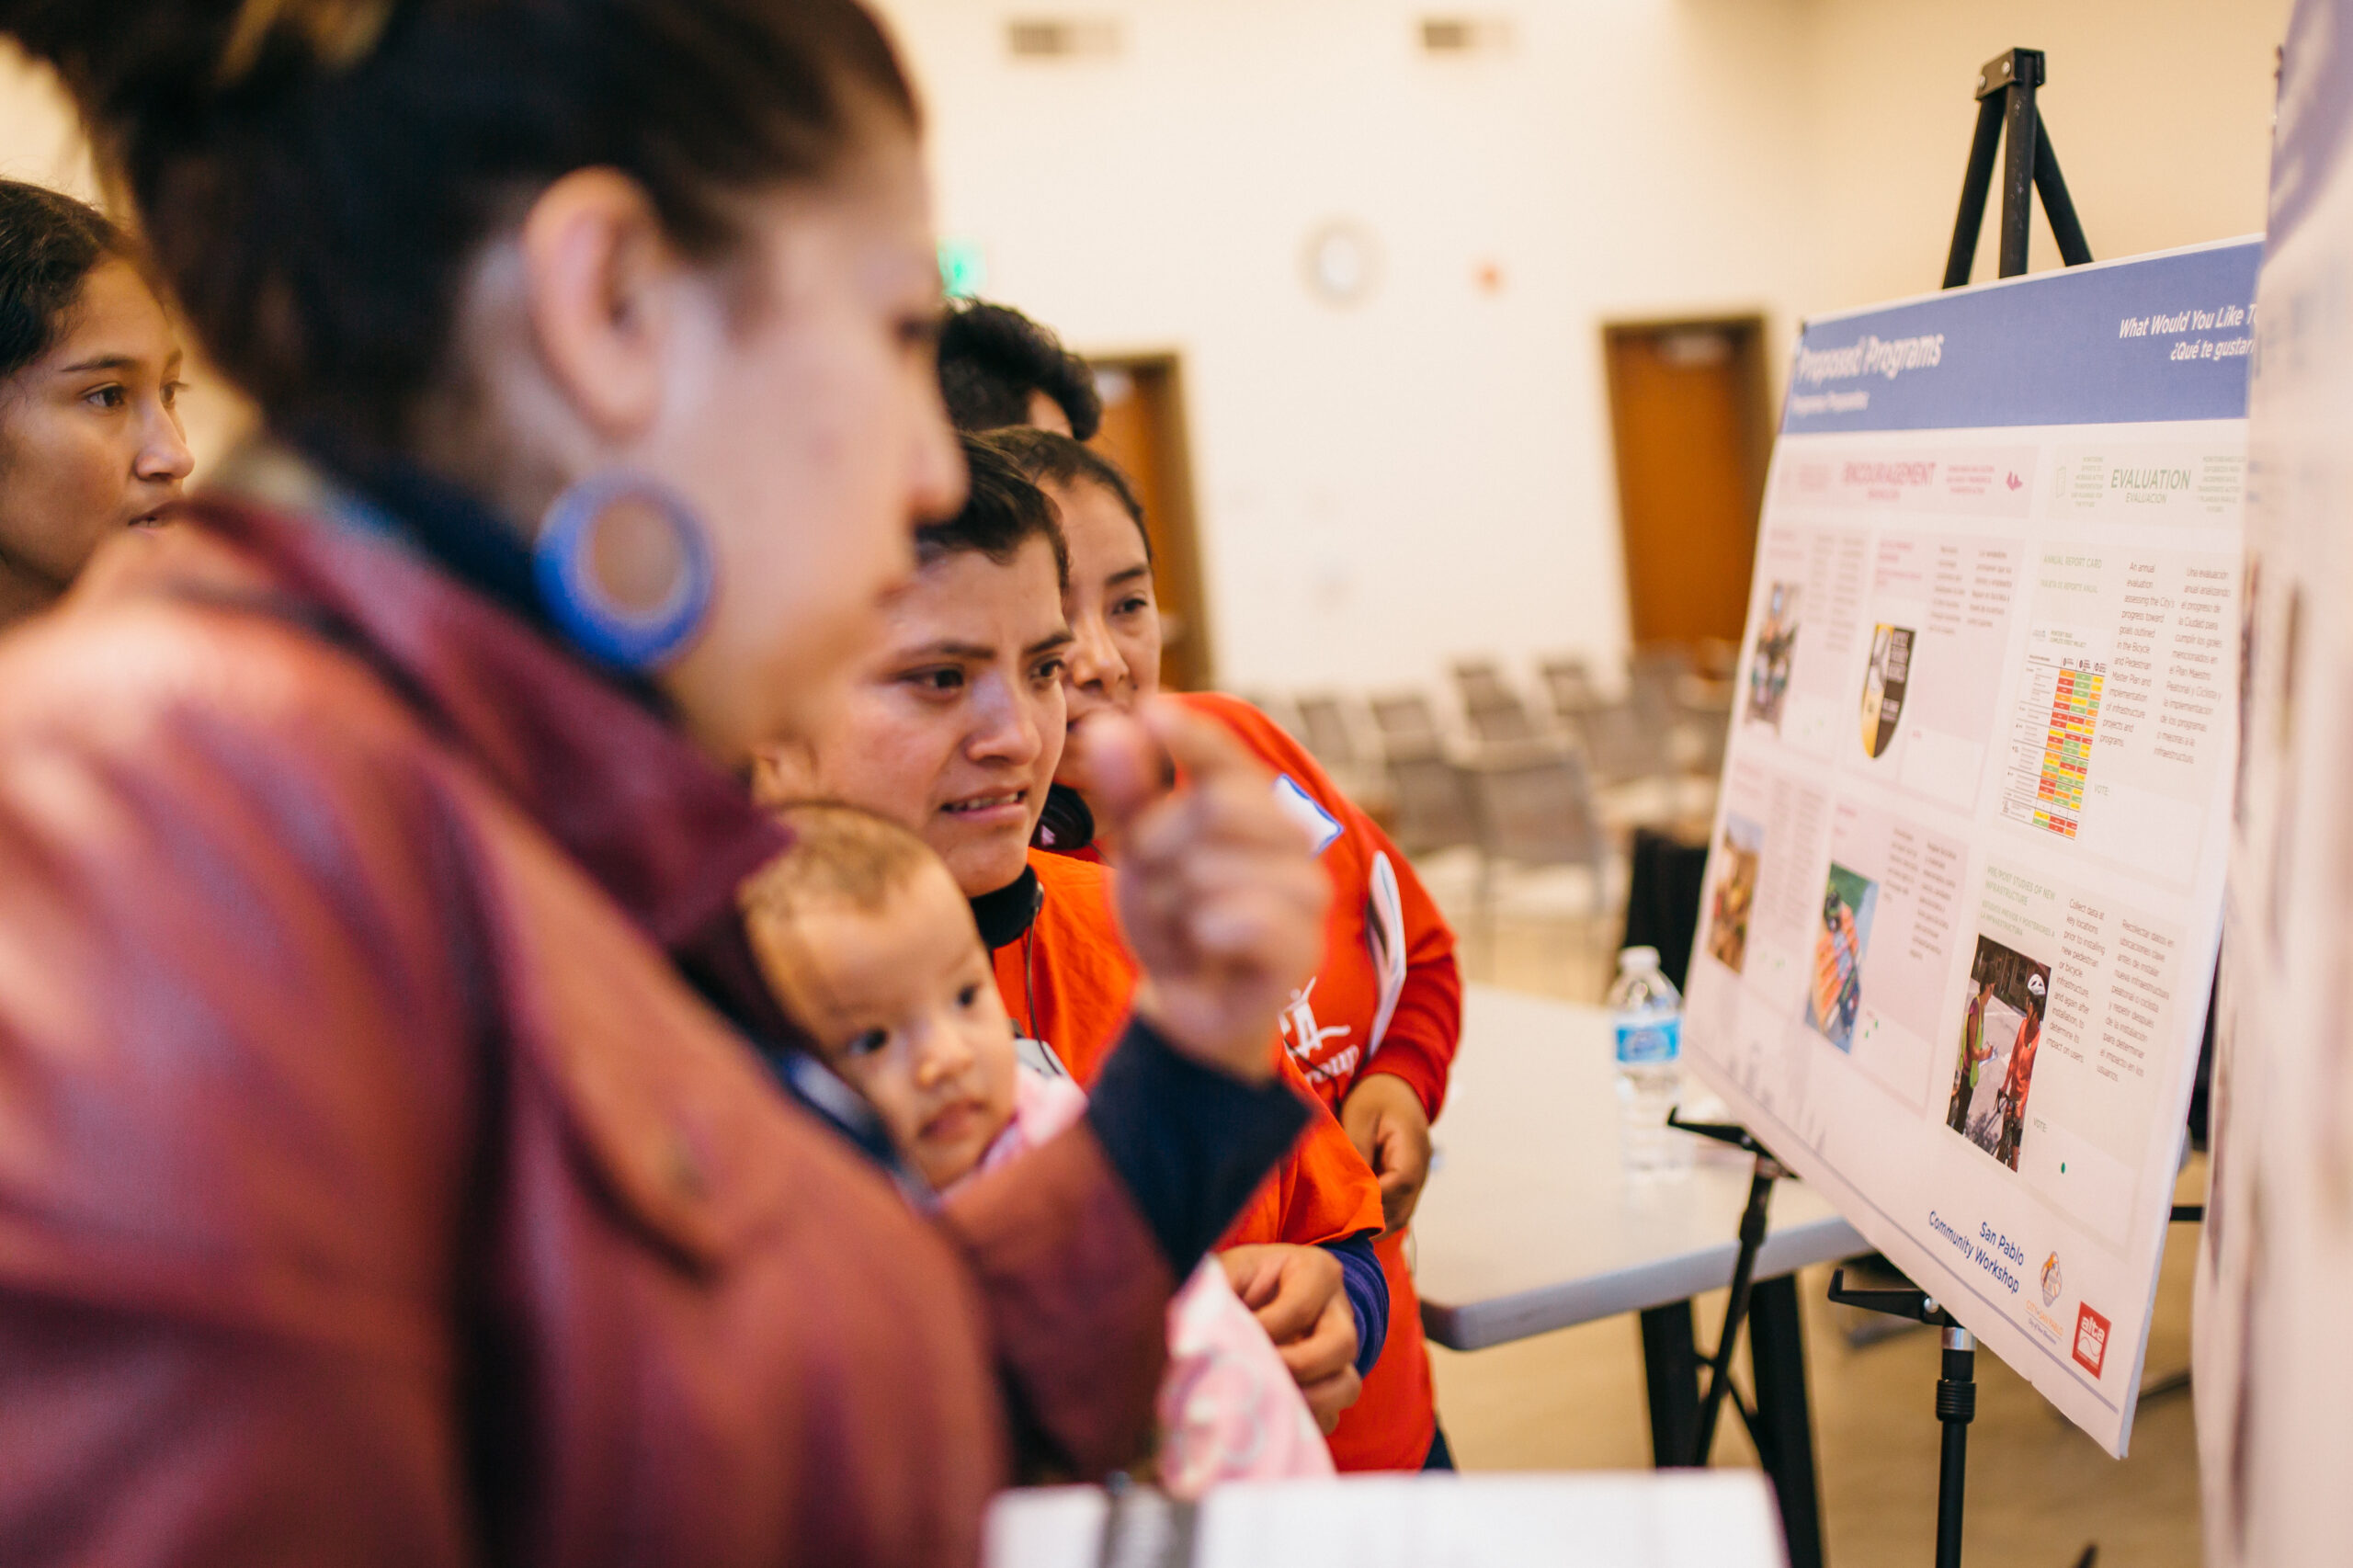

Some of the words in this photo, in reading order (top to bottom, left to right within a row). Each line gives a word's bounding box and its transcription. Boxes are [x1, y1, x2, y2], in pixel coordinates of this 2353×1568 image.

[2120, 317, 2149, 338] What
[2151, 311, 2191, 335] Would
[2191, 310, 2215, 331] You
[2215, 305, 2244, 328] Like
[1864, 333, 1945, 380] Programs
[2171, 338, 2201, 360] ¿Qué
[2200, 341, 2213, 358] te
[2110, 469, 2191, 490] EVALUATION
[2064, 556, 2086, 567] REPORT
[2086, 558, 2102, 569] CARD
[2129, 562, 2138, 571] An
[2138, 563, 2155, 574] annual
[2121, 610, 2143, 621] progress
[2145, 612, 2165, 623] toward
[2122, 641, 2131, 651] the
[2132, 642, 2151, 654] Bicycle
[2112, 671, 2129, 683] Master
[2129, 673, 2141, 685] Plan
[2140, 677, 2152, 687] and
[2106, 702, 2112, 711] of
[2103, 719, 2123, 731] projects
[2123, 722, 2134, 733] and
[2013, 875, 2033, 892] STUDIES
[2033, 884, 2042, 894] OF
[2042, 888, 2057, 901] NEW
[2070, 898, 2086, 912] Collect
[2086, 906, 2097, 918] data
[2098, 912, 2105, 921] at
[2066, 913, 2075, 926] key
[2075, 919, 2098, 935] locations
[2063, 930, 2076, 941] prior
[2077, 935, 2083, 945] to
[2083, 939, 2105, 956] installing
[2061, 945, 2072, 957] new
[2073, 950, 2099, 967] pedestrian
[2059, 961, 2065, 970] or
[2065, 961, 2083, 978] bicycle
[2054, 993, 2064, 1002] and
[2050, 1022, 2074, 1040] determine
[2046, 1037, 2063, 1051] impact
[1304, 1044, 1359, 1085] roup
[1929, 1210, 1974, 1259] Community
[1975, 1246, 2019, 1294] Workshop
[1980, 1221, 1996, 1246] San
[1998, 1235, 2024, 1267] Pablo
[2026, 1299, 2037, 1314] CITY
[2081, 1316, 2105, 1344] alta
